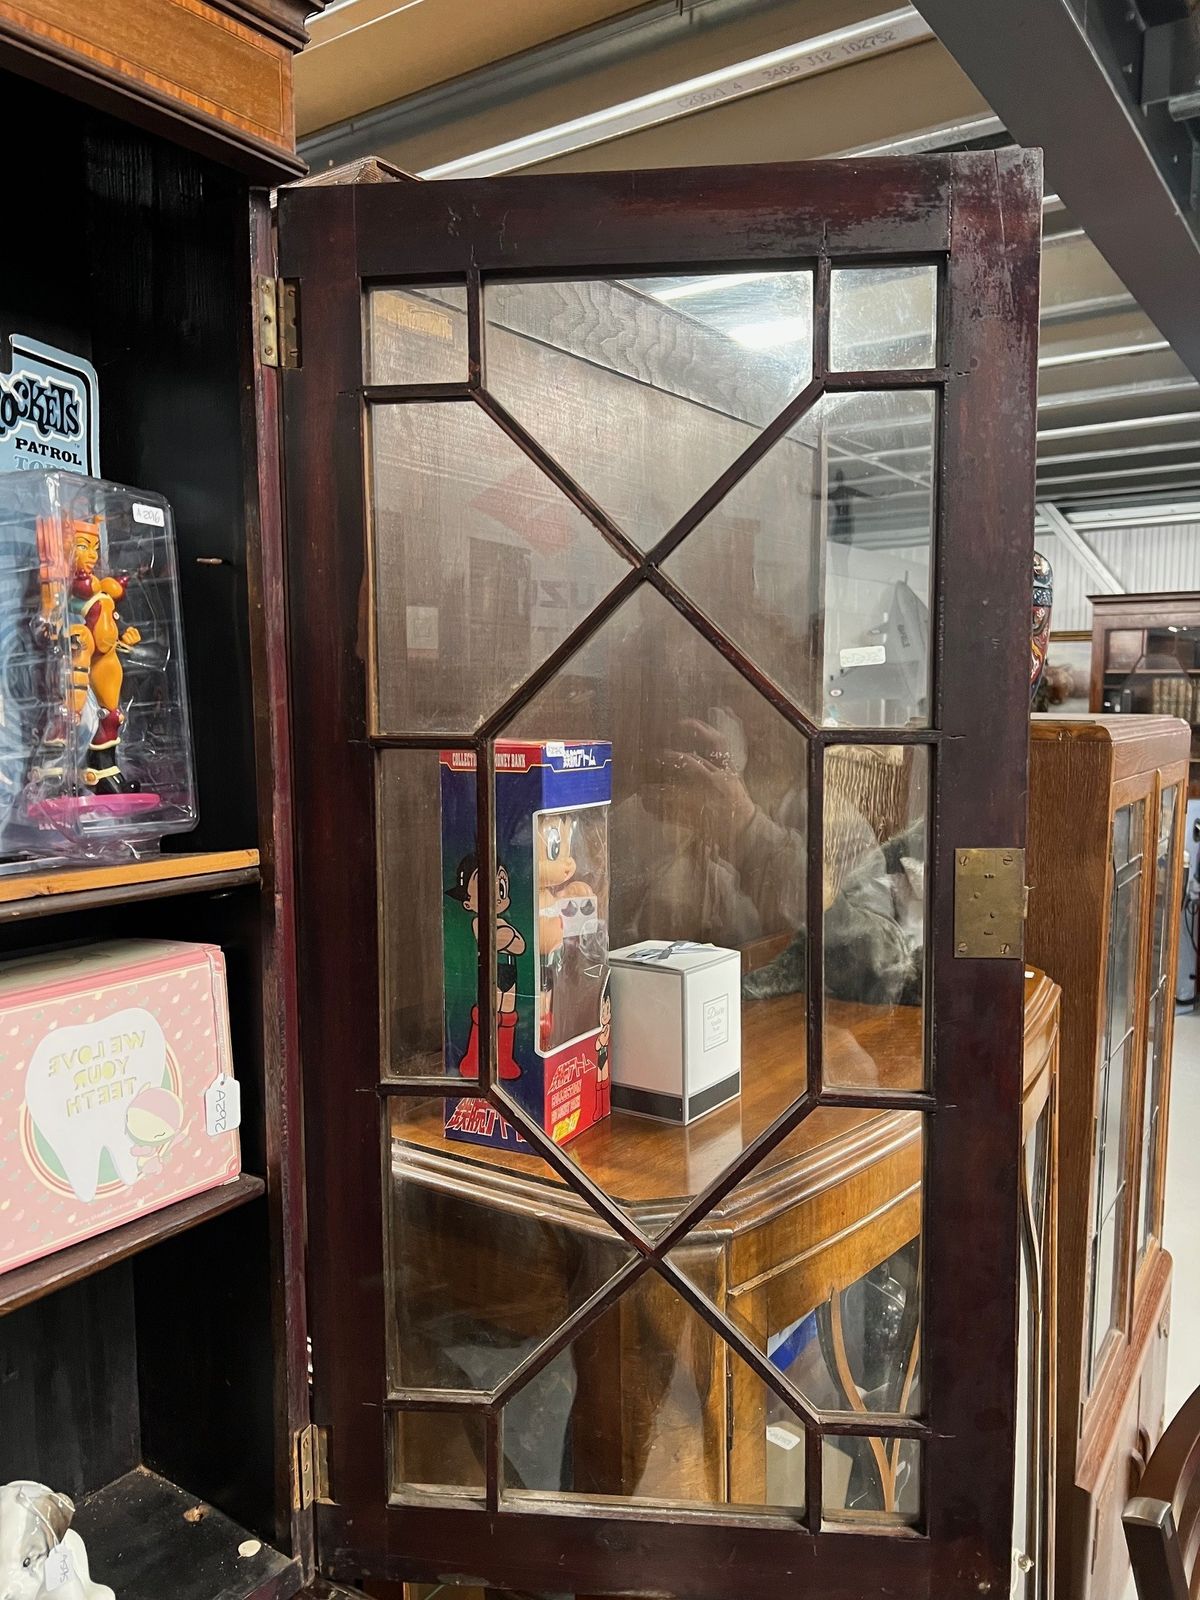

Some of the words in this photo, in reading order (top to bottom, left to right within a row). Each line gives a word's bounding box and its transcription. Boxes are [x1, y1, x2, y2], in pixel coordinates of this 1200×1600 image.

[0, 377, 80, 436] OCKETS
[14, 437, 82, 466] PATROL
[511, 753, 526, 768] BANK
[213, 1089, 228, 1133] A292
[445, 1098, 528, 1143] 鉄腕アト
